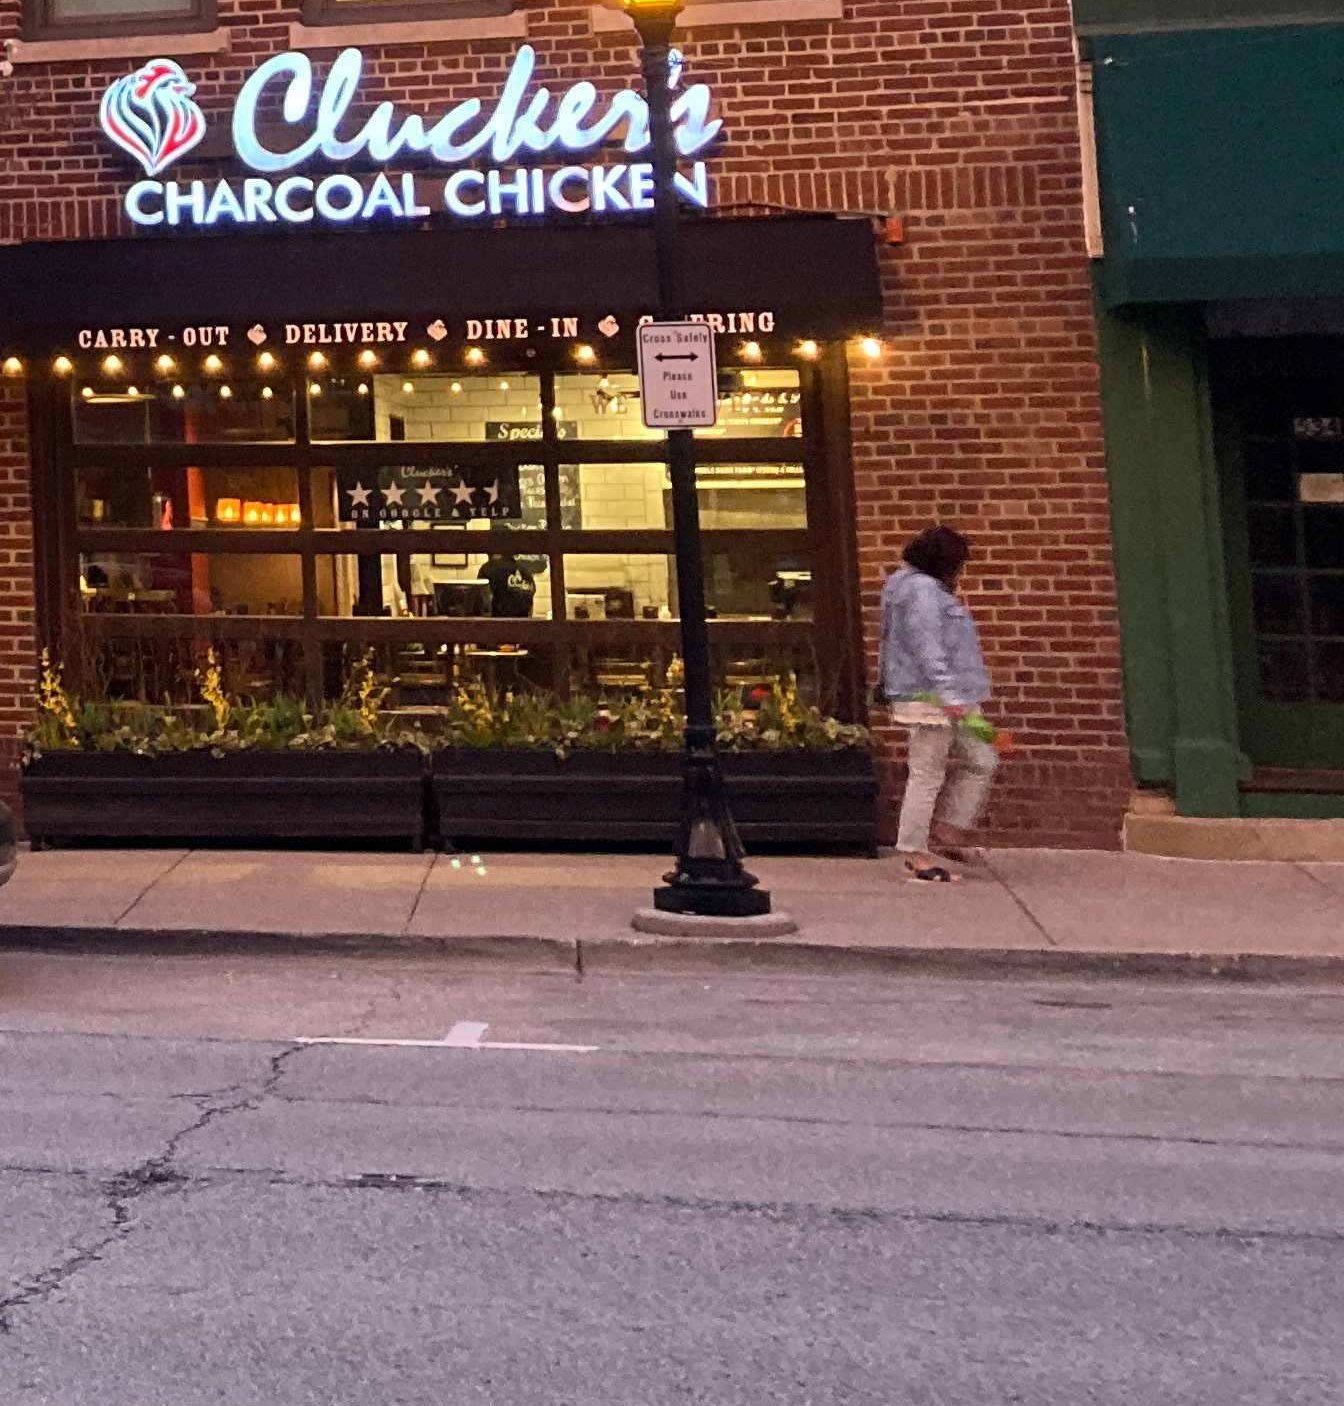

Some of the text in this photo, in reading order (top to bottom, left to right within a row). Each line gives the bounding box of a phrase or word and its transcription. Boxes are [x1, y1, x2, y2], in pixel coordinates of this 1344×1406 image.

[125, 161, 710, 226] CHARCOAL CHICKEN
[285, 321, 409, 344] DELIVERY
[643, 332, 708, 344] Cross Safely
[663, 371, 693, 381] Please
[670, 390, 687, 400] Use
[653, 409, 706, 419] Crosswalks
[498, 422, 567, 441] Specis
[350, 509, 370, 519] ON
[379, 508, 442, 518] GOOGLE
[469, 507, 510, 517] YELP
